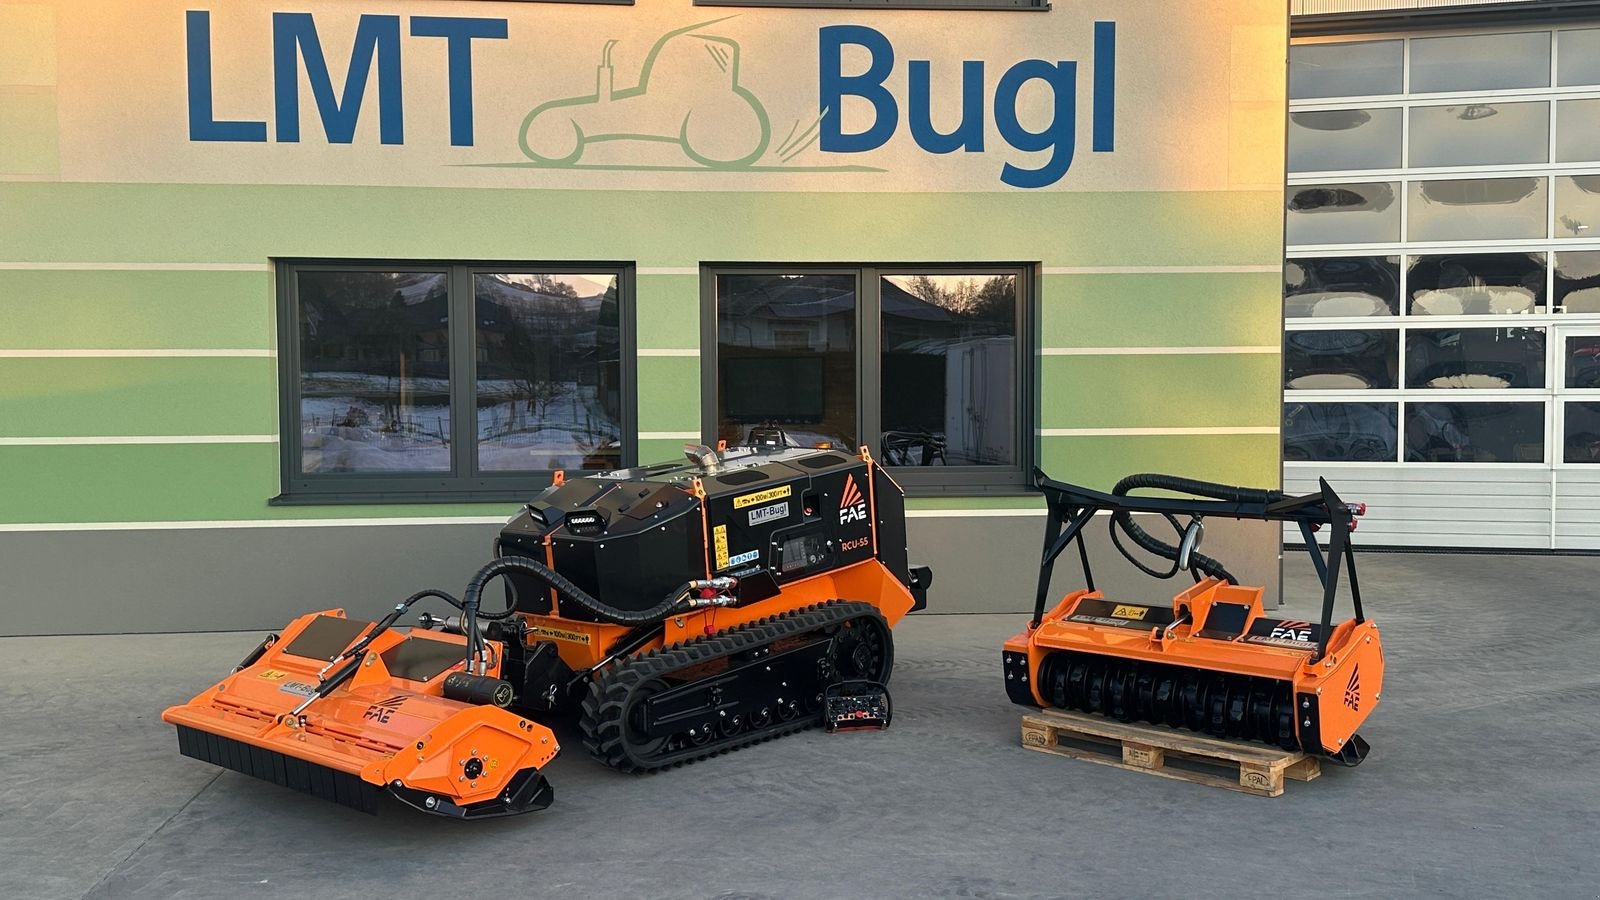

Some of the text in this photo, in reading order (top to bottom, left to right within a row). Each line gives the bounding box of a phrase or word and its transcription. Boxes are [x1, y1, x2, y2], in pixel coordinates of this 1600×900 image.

[187, 10, 1116, 188] LMT Bugl
[751, 503, 787, 520] LMT-Bugl
[839, 503, 867, 525] FAE
[841, 536, 869, 551] RCU-55
[1270, 627, 1312, 642] FAE
[1343, 690, 1360, 712] FAE
[362, 705, 396, 724] FAE
